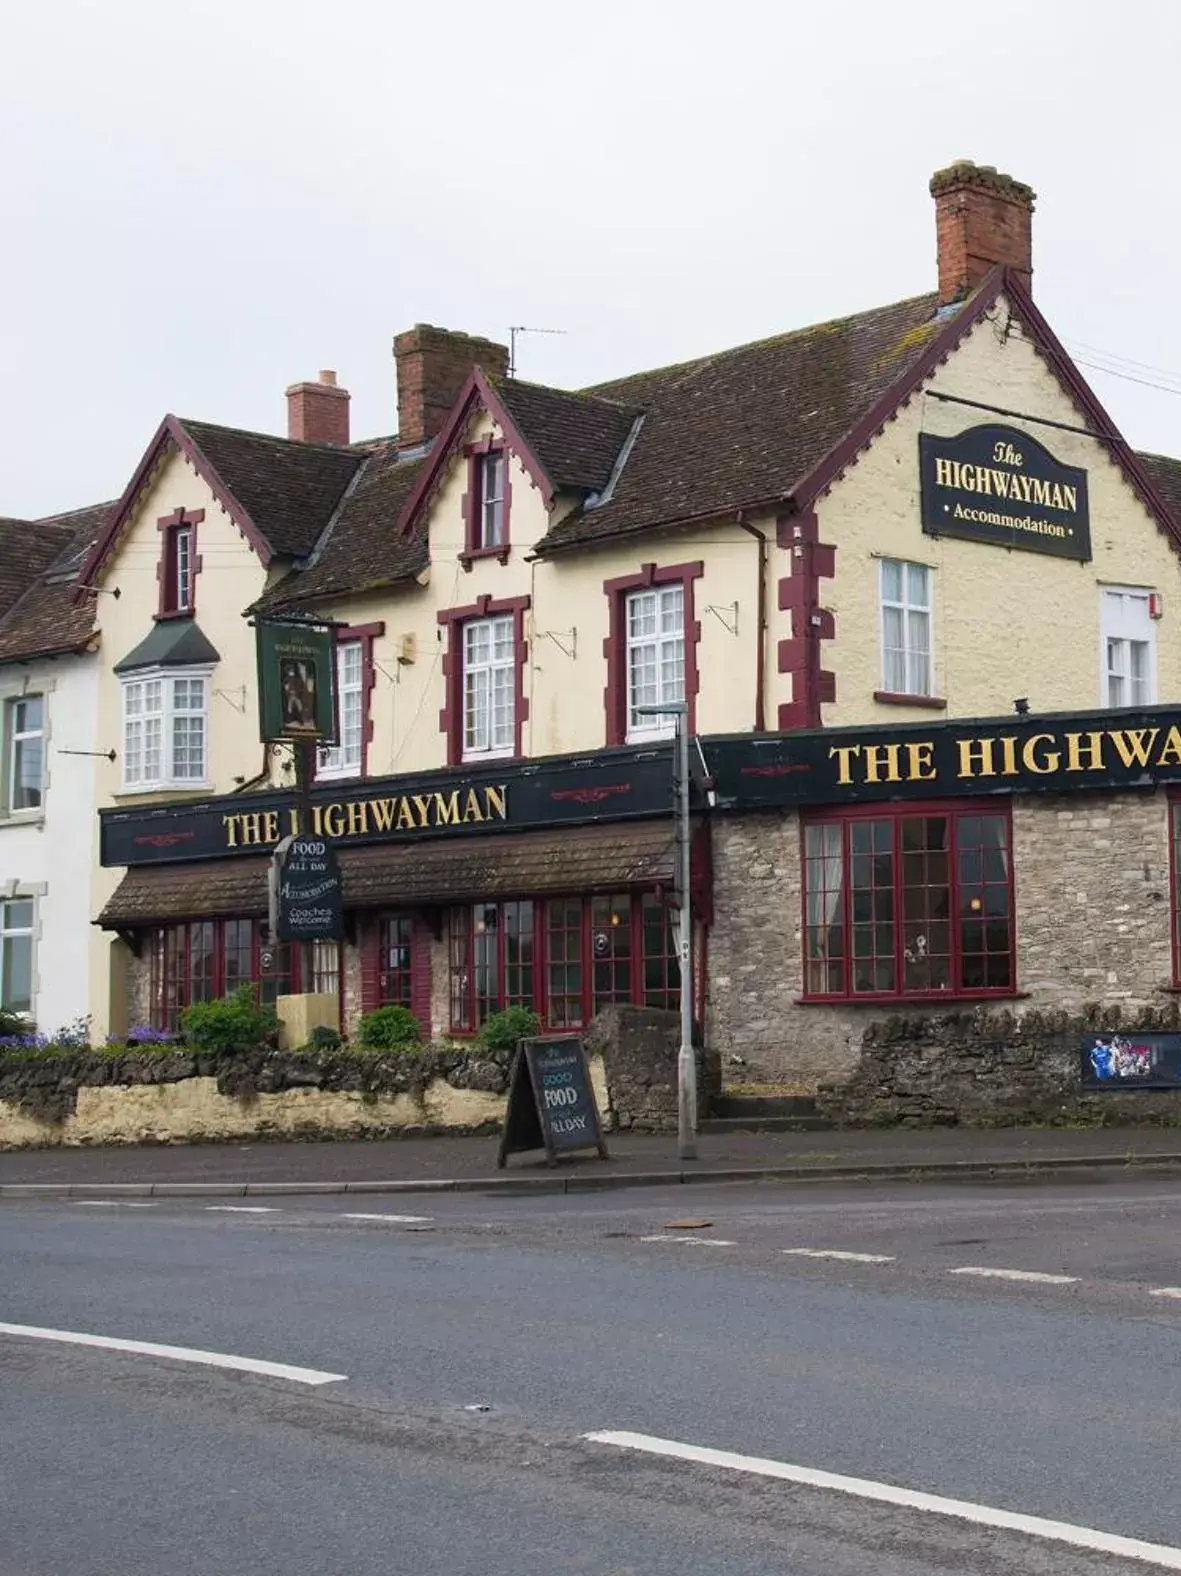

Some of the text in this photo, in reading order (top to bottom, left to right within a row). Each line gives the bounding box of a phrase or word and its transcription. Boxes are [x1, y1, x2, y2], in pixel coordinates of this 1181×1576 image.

[992, 441, 1024, 467] The
[935, 457, 1077, 513] HIGHWAYMAN
[953, 504, 1066, 538] Accommodation
[829, 740, 938, 785] THE
[222, 810, 280, 847] THE
[292, 841, 326, 856] FOOD
[289, 862, 305, 871] ALL
[289, 907, 333, 918] Coaches
[544, 1087, 578, 1109] FOOD
